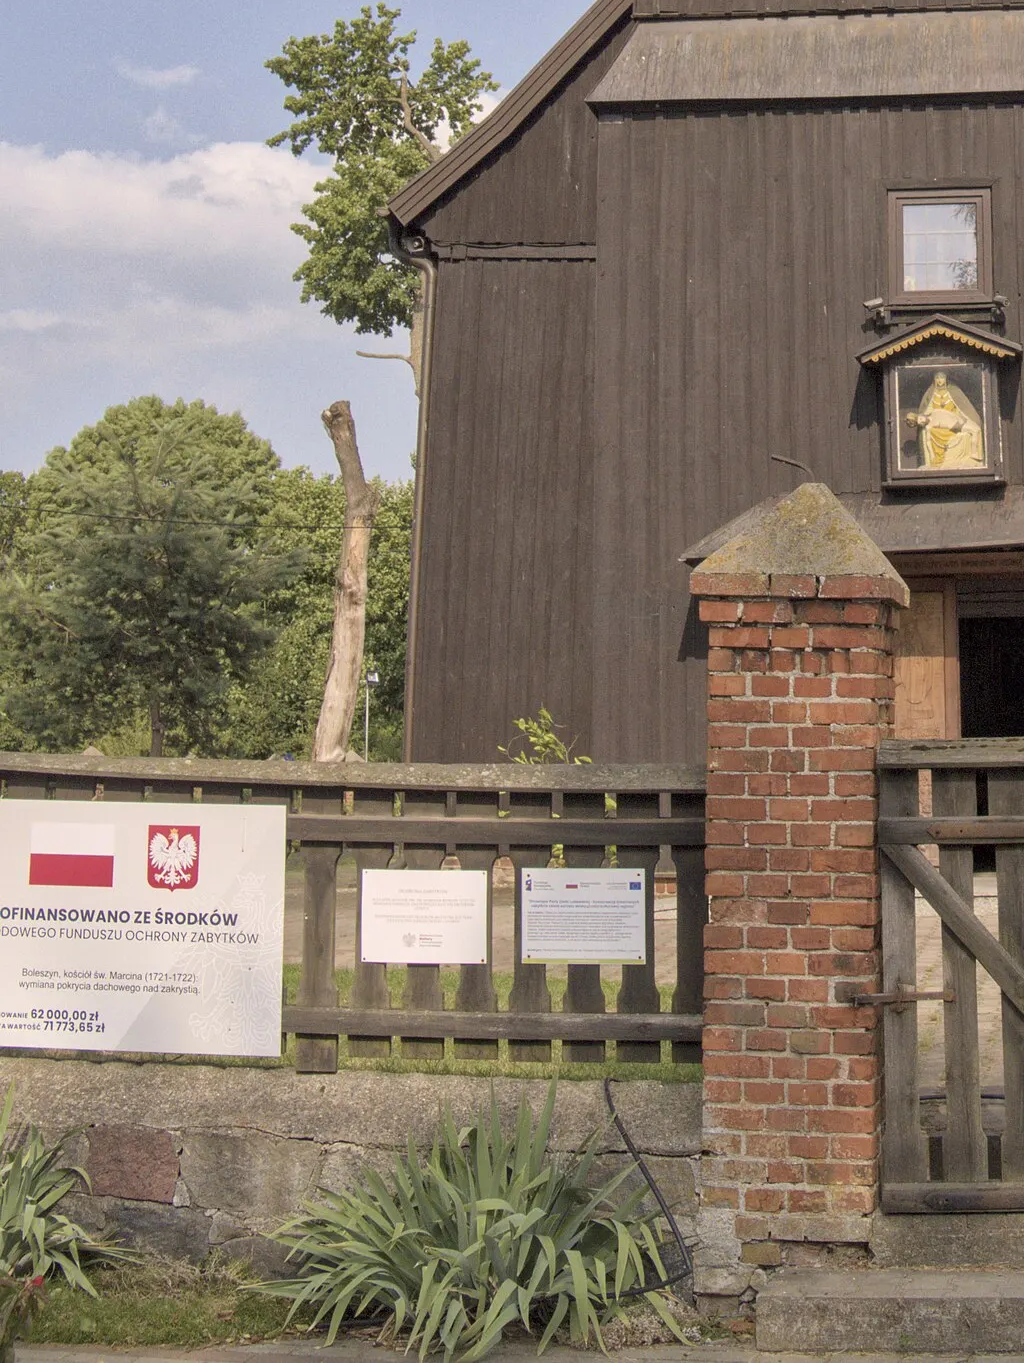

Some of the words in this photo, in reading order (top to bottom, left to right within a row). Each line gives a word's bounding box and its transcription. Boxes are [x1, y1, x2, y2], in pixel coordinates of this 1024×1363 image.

[0, 907, 131, 923] OFINANSOWANO
[134, 911, 151, 924] ZE
[154, 907, 239, 926] ŚRODKÓW
[0, 926, 56, 938] DOWEGO
[60, 927, 122, 940] FUNDUSZU
[125, 929, 188, 942] OCHRONY
[190, 930, 260, 944] ZABYTKÓW
[21, 968, 61, 979] Boleszyn,
[63, 969, 92, 979] kościół
[94, 970, 107, 979] św.
[109, 971, 143, 981] Marcina
[19, 980, 55, 990] wymiana
[57, 981, 91, 992] pokrycia
[93, 982, 141, 993] dachowego
[143, 984, 159, 993] nad
[160, 984, 200, 996] zakrystią.
[89, 1011, 99, 1021] zł
[95, 1022, 105, 1033] zł
